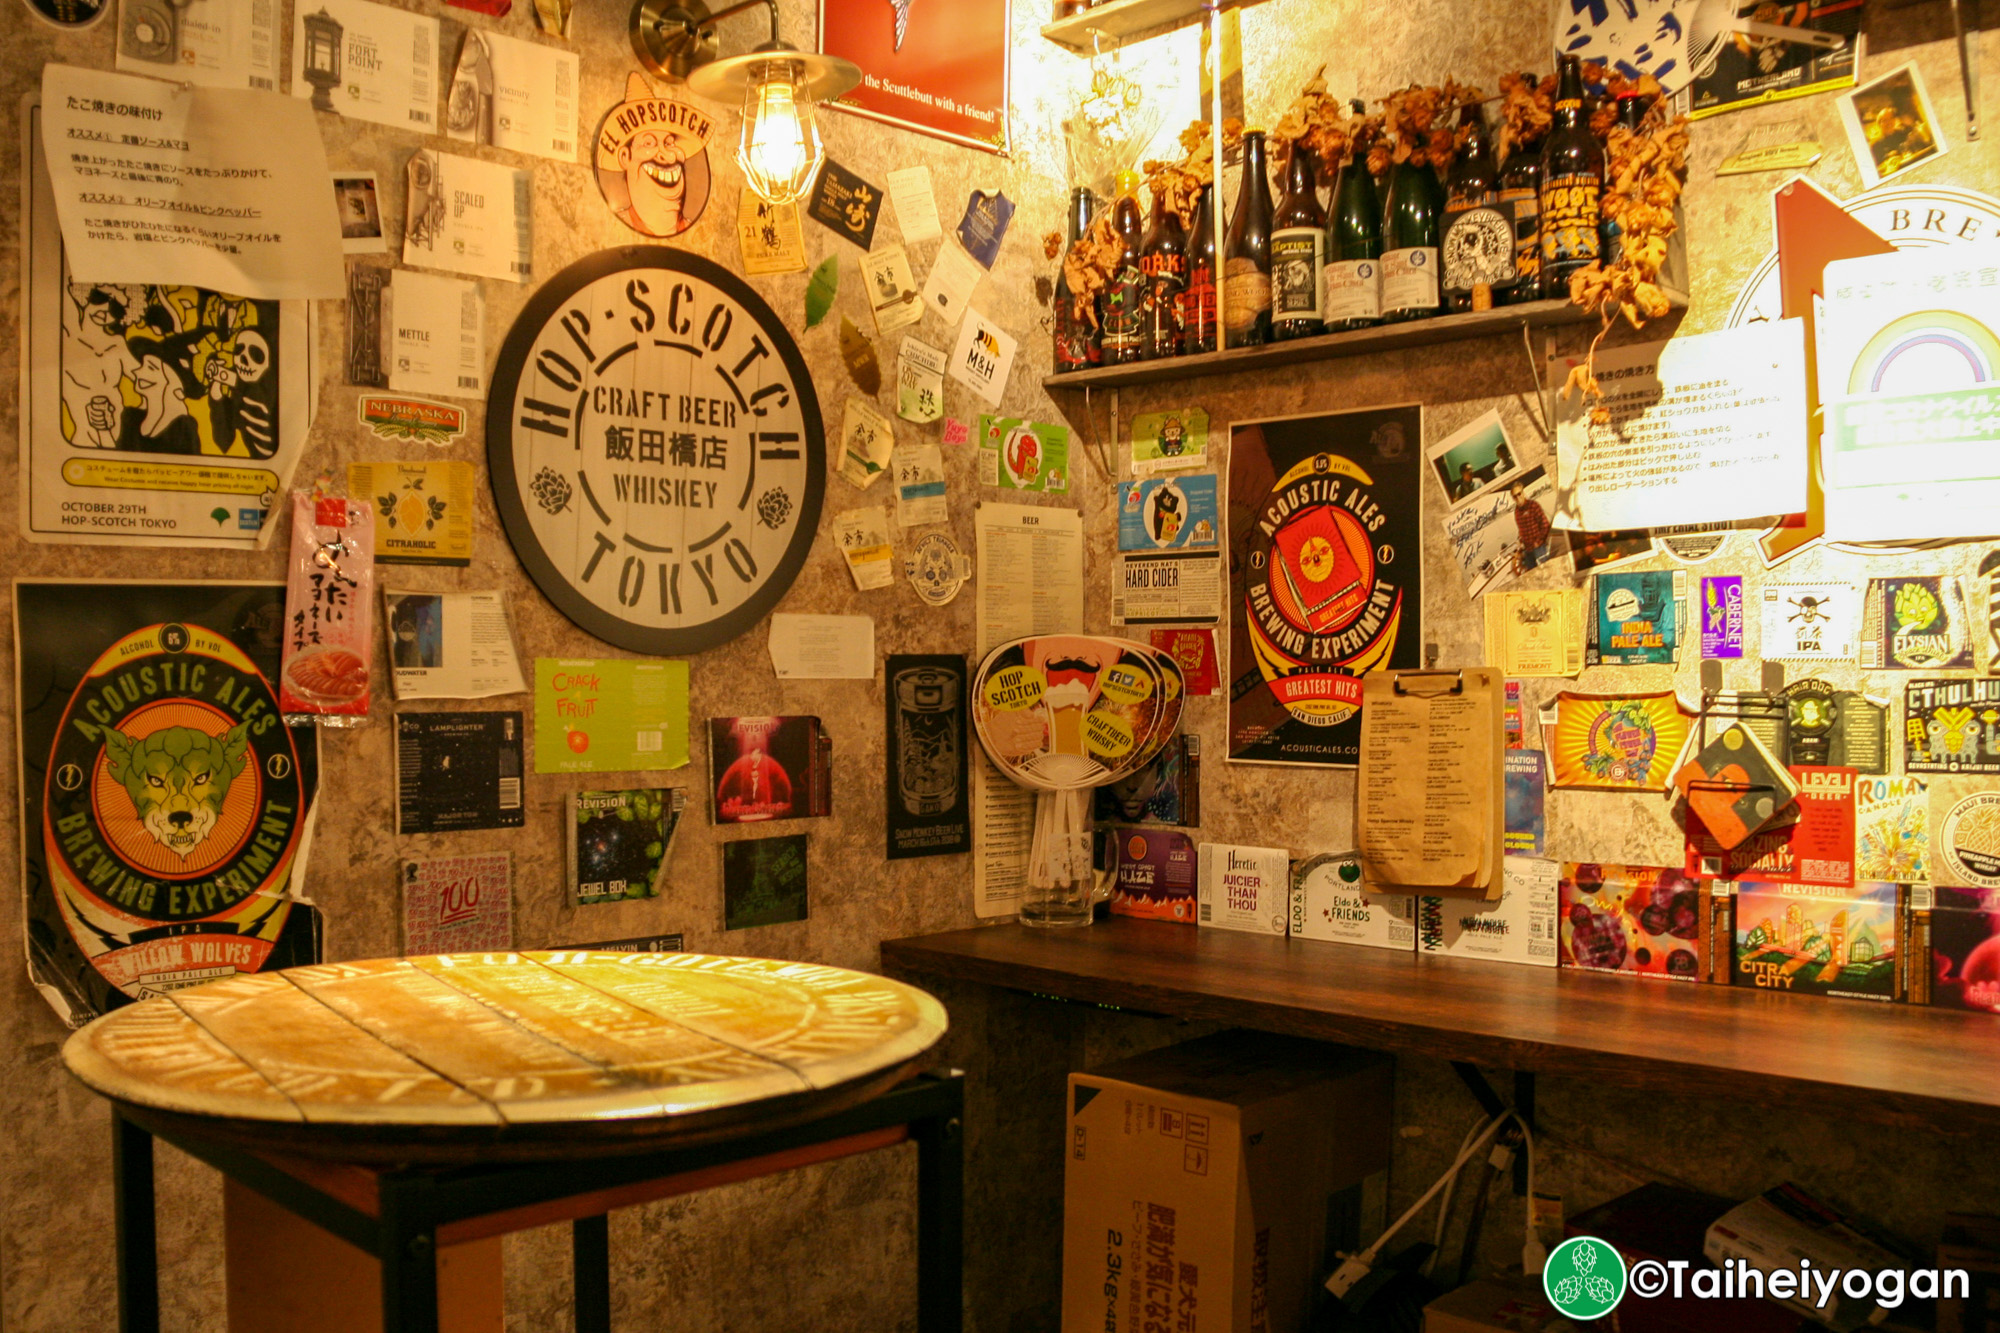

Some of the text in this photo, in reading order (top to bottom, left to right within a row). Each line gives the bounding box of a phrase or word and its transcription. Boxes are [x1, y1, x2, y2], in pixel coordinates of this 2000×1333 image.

[348, 43, 379, 60] FORT
[347, 54, 383, 72] POINT
[864, 73, 995, 124] the Scuttlebutt with a friend!
[66, 95, 163, 121] たこ焼きの味付け
[600, 101, 711, 155] EL HOPSCOTCH
[453, 189, 485, 209] SCALED
[453, 203, 465, 218] UP
[744, 225, 757, 239] 21
[399, 328, 431, 342] METTLE
[966, 347, 996, 380] M&H
[370, 401, 455, 421] NEBRASKA
[592, 384, 737, 429] CRAFT BEER
[604, 424, 728, 471] 飯田橋店
[613, 473, 718, 510] WHISKEY
[61, 501, 148, 515] OCTOBER 29TH
[1259, 479, 1341, 537] ACOUSTIC
[1343, 487, 1387, 533] ALES
[61, 515, 178, 530] HOP-SCOTCH TOKYO
[1022, 516, 1040, 526] BEER
[385, 538, 437, 550] CITRAHOLIC
[581, 530, 758, 616] TOKYO
[1125, 567, 1179, 589] HARD CIDER
[1250, 582, 1306, 656] BREWING
[1311, 578, 1395, 660] EXPERIMENT
[1727, 584, 1743, 650] CABERNET
[1621, 621, 1653, 634] INDIA
[119, 632, 222, 657] ALCOHOL 6% BY VOL
[1611, 633, 1664, 649] PALE ALE
[1796, 642, 1822, 652] IPA
[1893, 634, 1950, 655] ELYSIAN
[999, 670, 1024, 689] HOP
[1298, 666, 1345, 675] PALE ALE
[551, 672, 601, 693] CRACK
[1285, 679, 1358, 699] GREATEST HITS
[1786, 680, 1832, 697] HAIR DOG
[73, 662, 277, 743] ACOUSTIC ALES
[991, 681, 1042, 707] SCOTCH
[1908, 680, 2000, 709] CTHULHU
[556, 698, 599, 719] FRUIT
[1009, 699, 1028, 710] TOKYO
[1293, 709, 1306, 722] SAN
[1307, 714, 1327, 725] DIEGO
[429, 723, 485, 733] LAMPLIGHTER
[1087, 713, 1132, 748] CRAFTBEER
[1087, 728, 1118, 752] WHISKY
[1281, 743, 1359, 755] ACOUSTICALES.CO
[560, 760, 593, 770] PALE ALE
[1801, 771, 1852, 792] LEVEL
[576, 795, 627, 811] REVISION
[1810, 793, 1841, 801] BEER
[1954, 797, 2000, 818] MAUI BRE
[950, 823, 965, 835] LIVE
[56, 799, 294, 916] BREWING EXPERIMENT
[1228, 850, 1258, 872] Heretic
[1959, 851, 1995, 865] PINEAPPLE
[1953, 860, 2000, 886] ISLAND BRE
[1973, 862, 1998, 873] WHEAT
[1120, 869, 1155, 885] HAZE
[1223, 873, 1261, 888] JUICIER
[1324, 874, 1361, 892] PORTLAND
[576, 879, 628, 898] JEWEL BOX
[1227, 886, 1258, 900] THAN
[1782, 884, 1847, 897] REVISION
[438, 876, 481, 923] 100
[1227, 897, 1258, 912] THOU
[1333, 895, 1361, 909] Eldo &
[1292, 905, 1303, 934] ELDO
[1331, 907, 1371, 923] FRIENDS
[117, 941, 253, 974] WILLOW WOLVES
[151, 967, 224, 983] INDIA PALE ALE
[1739, 960, 1791, 977] CITRA
[1755, 973, 1796, 990] CITY
[1176, 1260, 1200, 1333] 愛犬元
